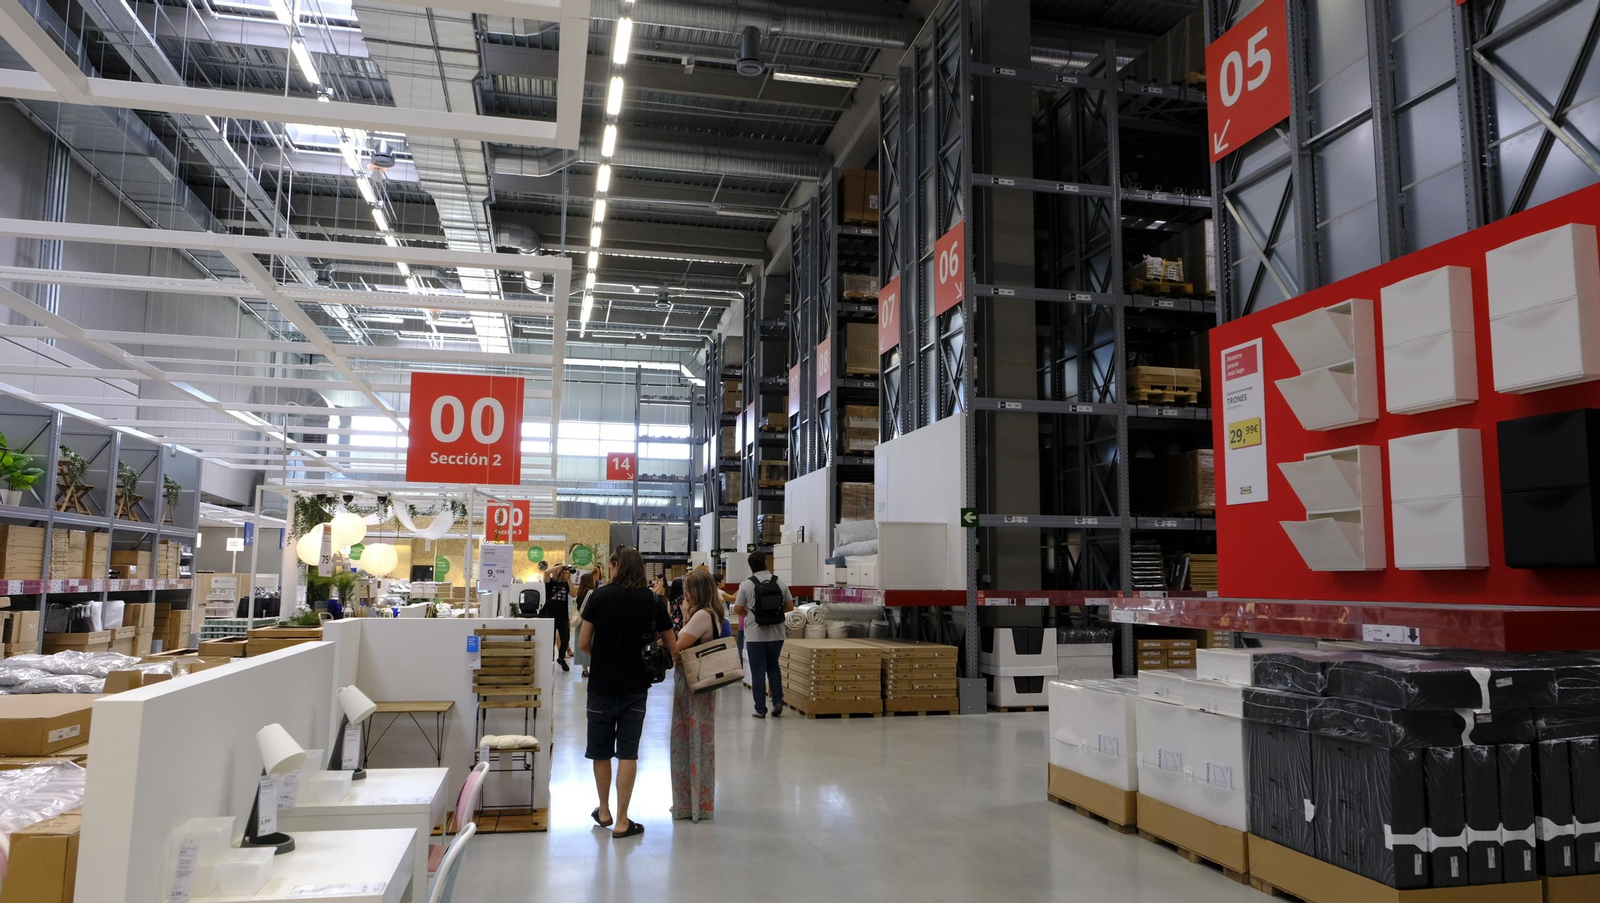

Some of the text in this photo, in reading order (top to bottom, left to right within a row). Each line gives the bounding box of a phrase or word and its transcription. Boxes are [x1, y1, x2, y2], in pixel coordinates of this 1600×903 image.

[1219, 25, 1272, 108] 05
[939, 240, 959, 286] 06
[881, 292, 896, 329] 07
[818, 348, 829, 377] 08
[1227, 352, 1243, 361] Nuestro
[1227, 361, 1240, 370] precio
[1227, 367, 1245, 377] más bajo
[1226, 394, 1248, 405] TRONES
[430, 395, 505, 445] 00
[1230, 424, 1258, 444] 29,99€
[430, 450, 502, 466] Sección 2
[611, 456, 631, 471] 14
[494, 507, 524, 527] 00
[486, 568, 506, 578] 9,99€
